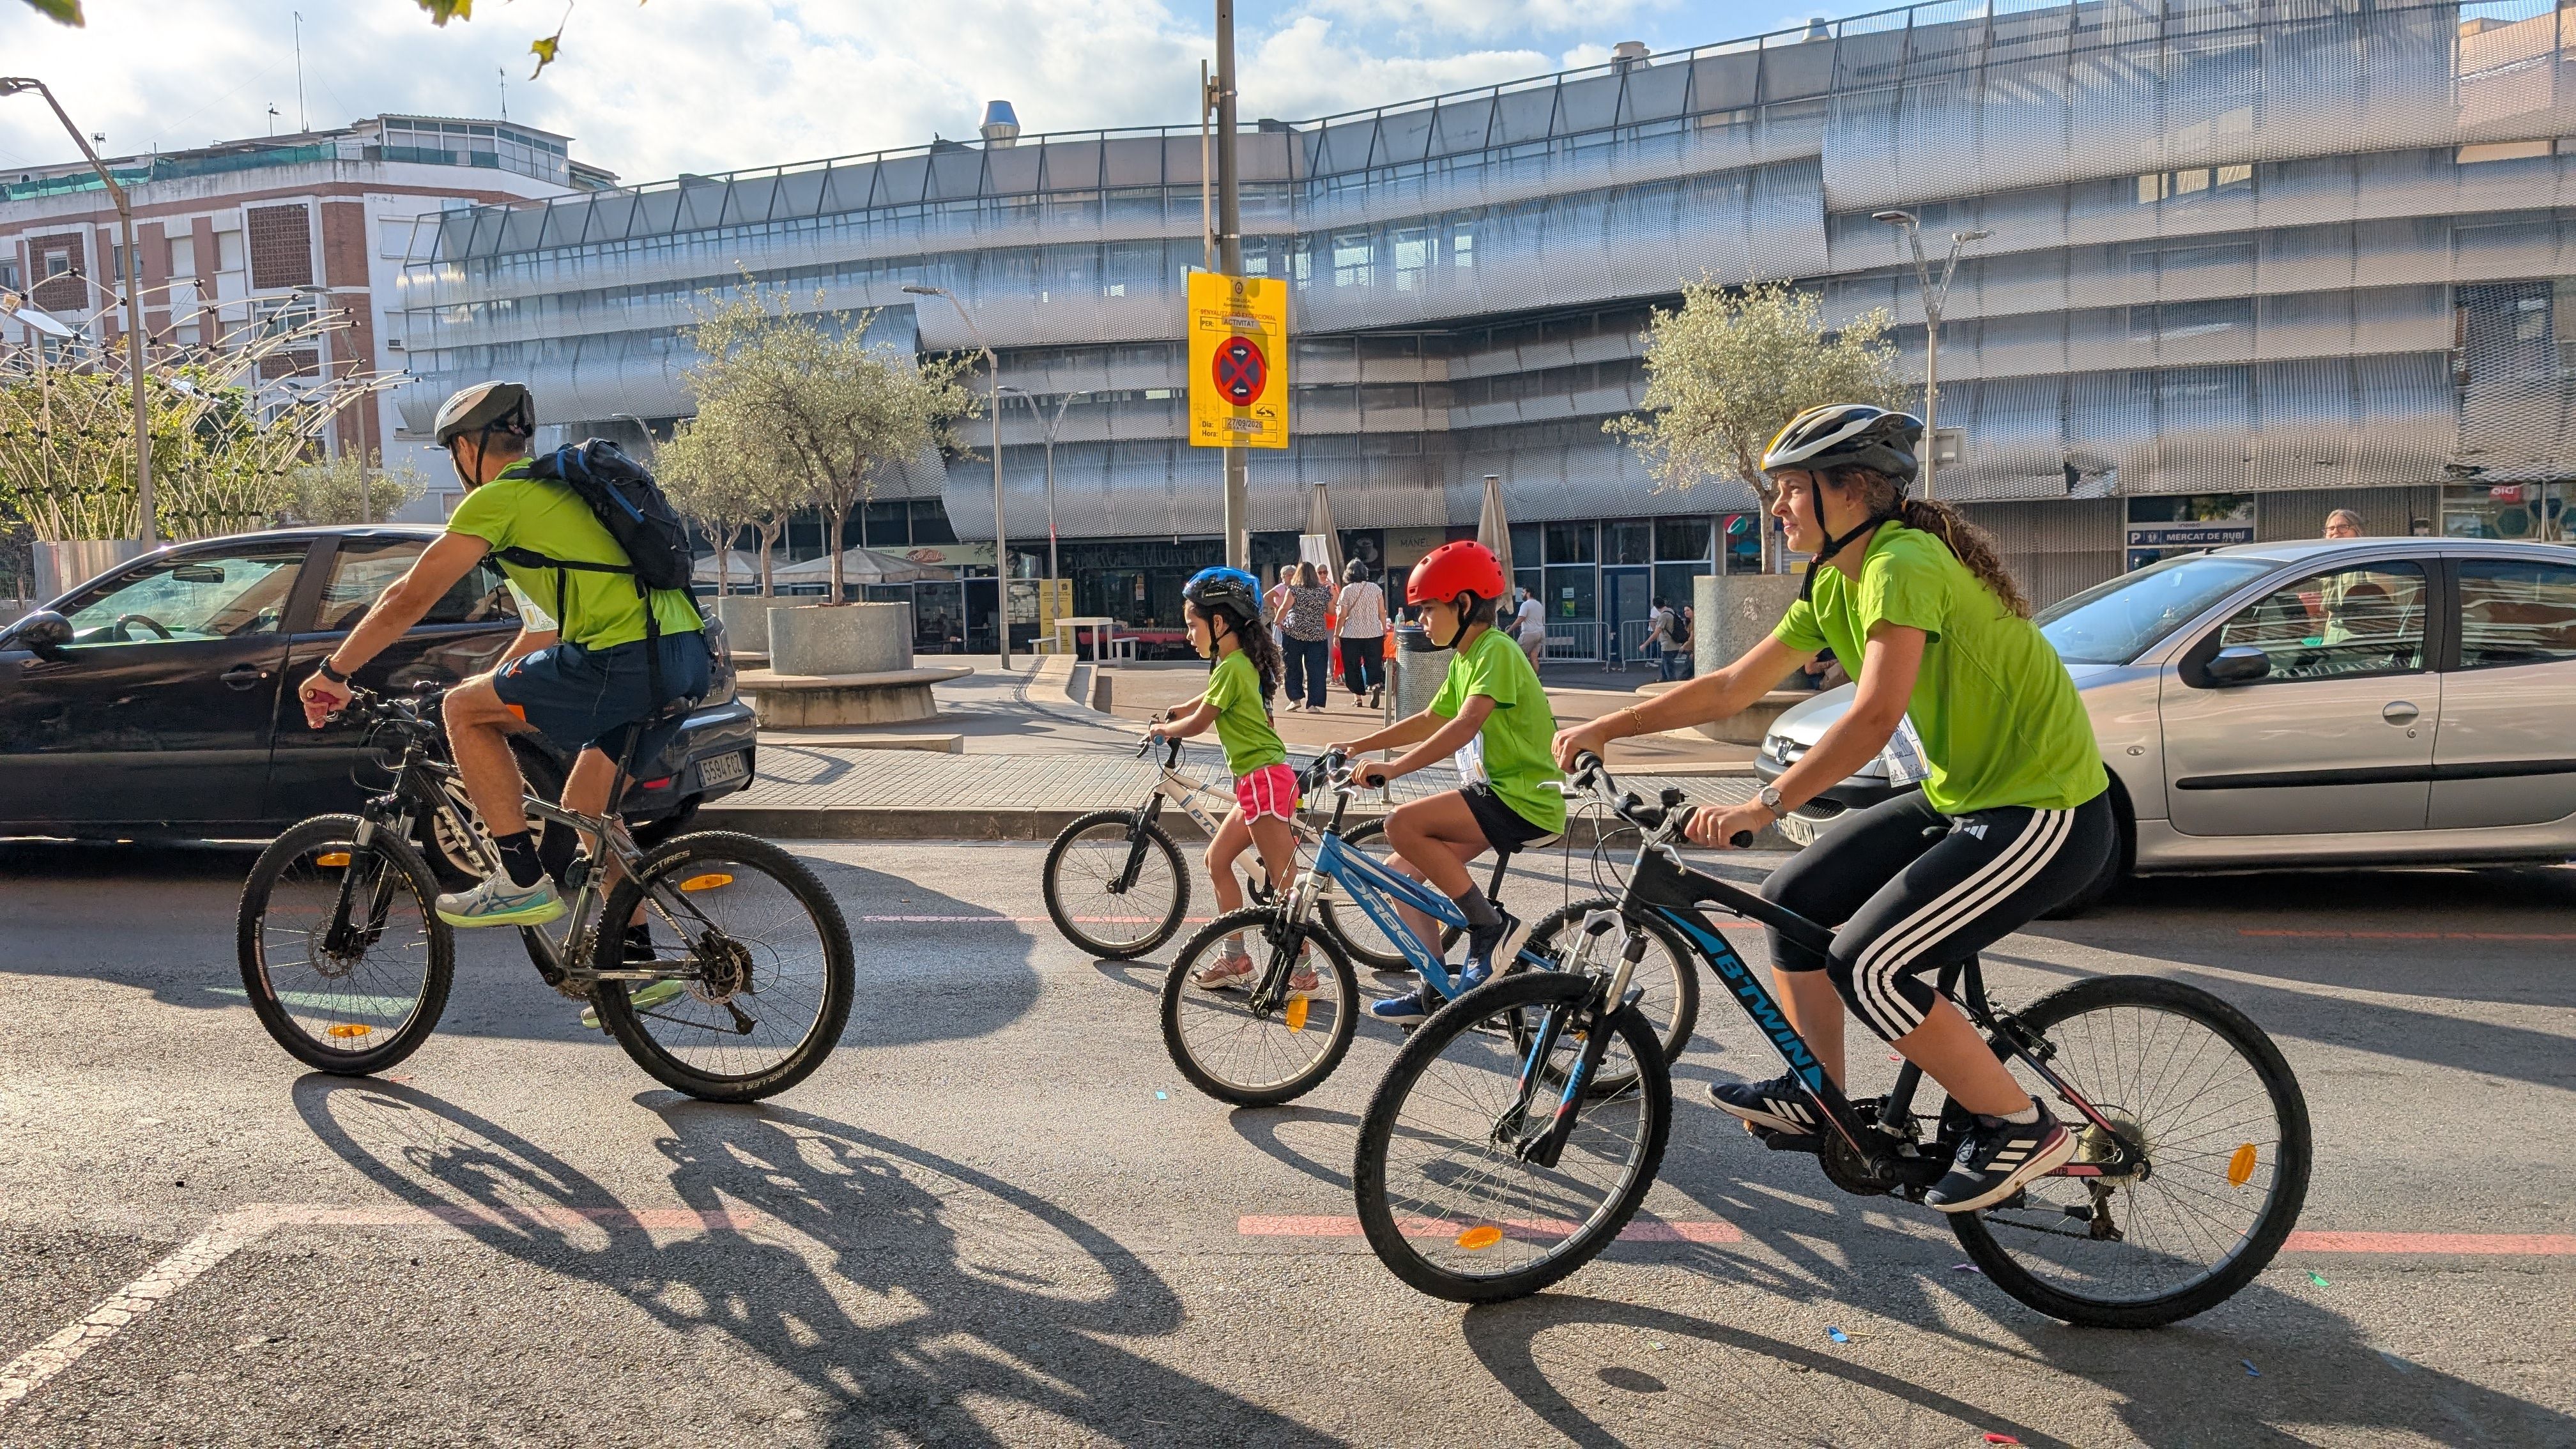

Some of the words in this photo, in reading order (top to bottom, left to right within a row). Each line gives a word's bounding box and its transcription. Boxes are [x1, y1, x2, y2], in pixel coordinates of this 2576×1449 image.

[1200, 309, 1241, 318] SENYALITZACIÓ
[1241, 312, 1276, 321] EXCEPCIONAL
[1223, 319, 1255, 328] ACTIVITAT
[703, 759, 727, 781] 5594
[657, 850, 691, 868] TIRES
[1342, 867, 1430, 969] ORBEA
